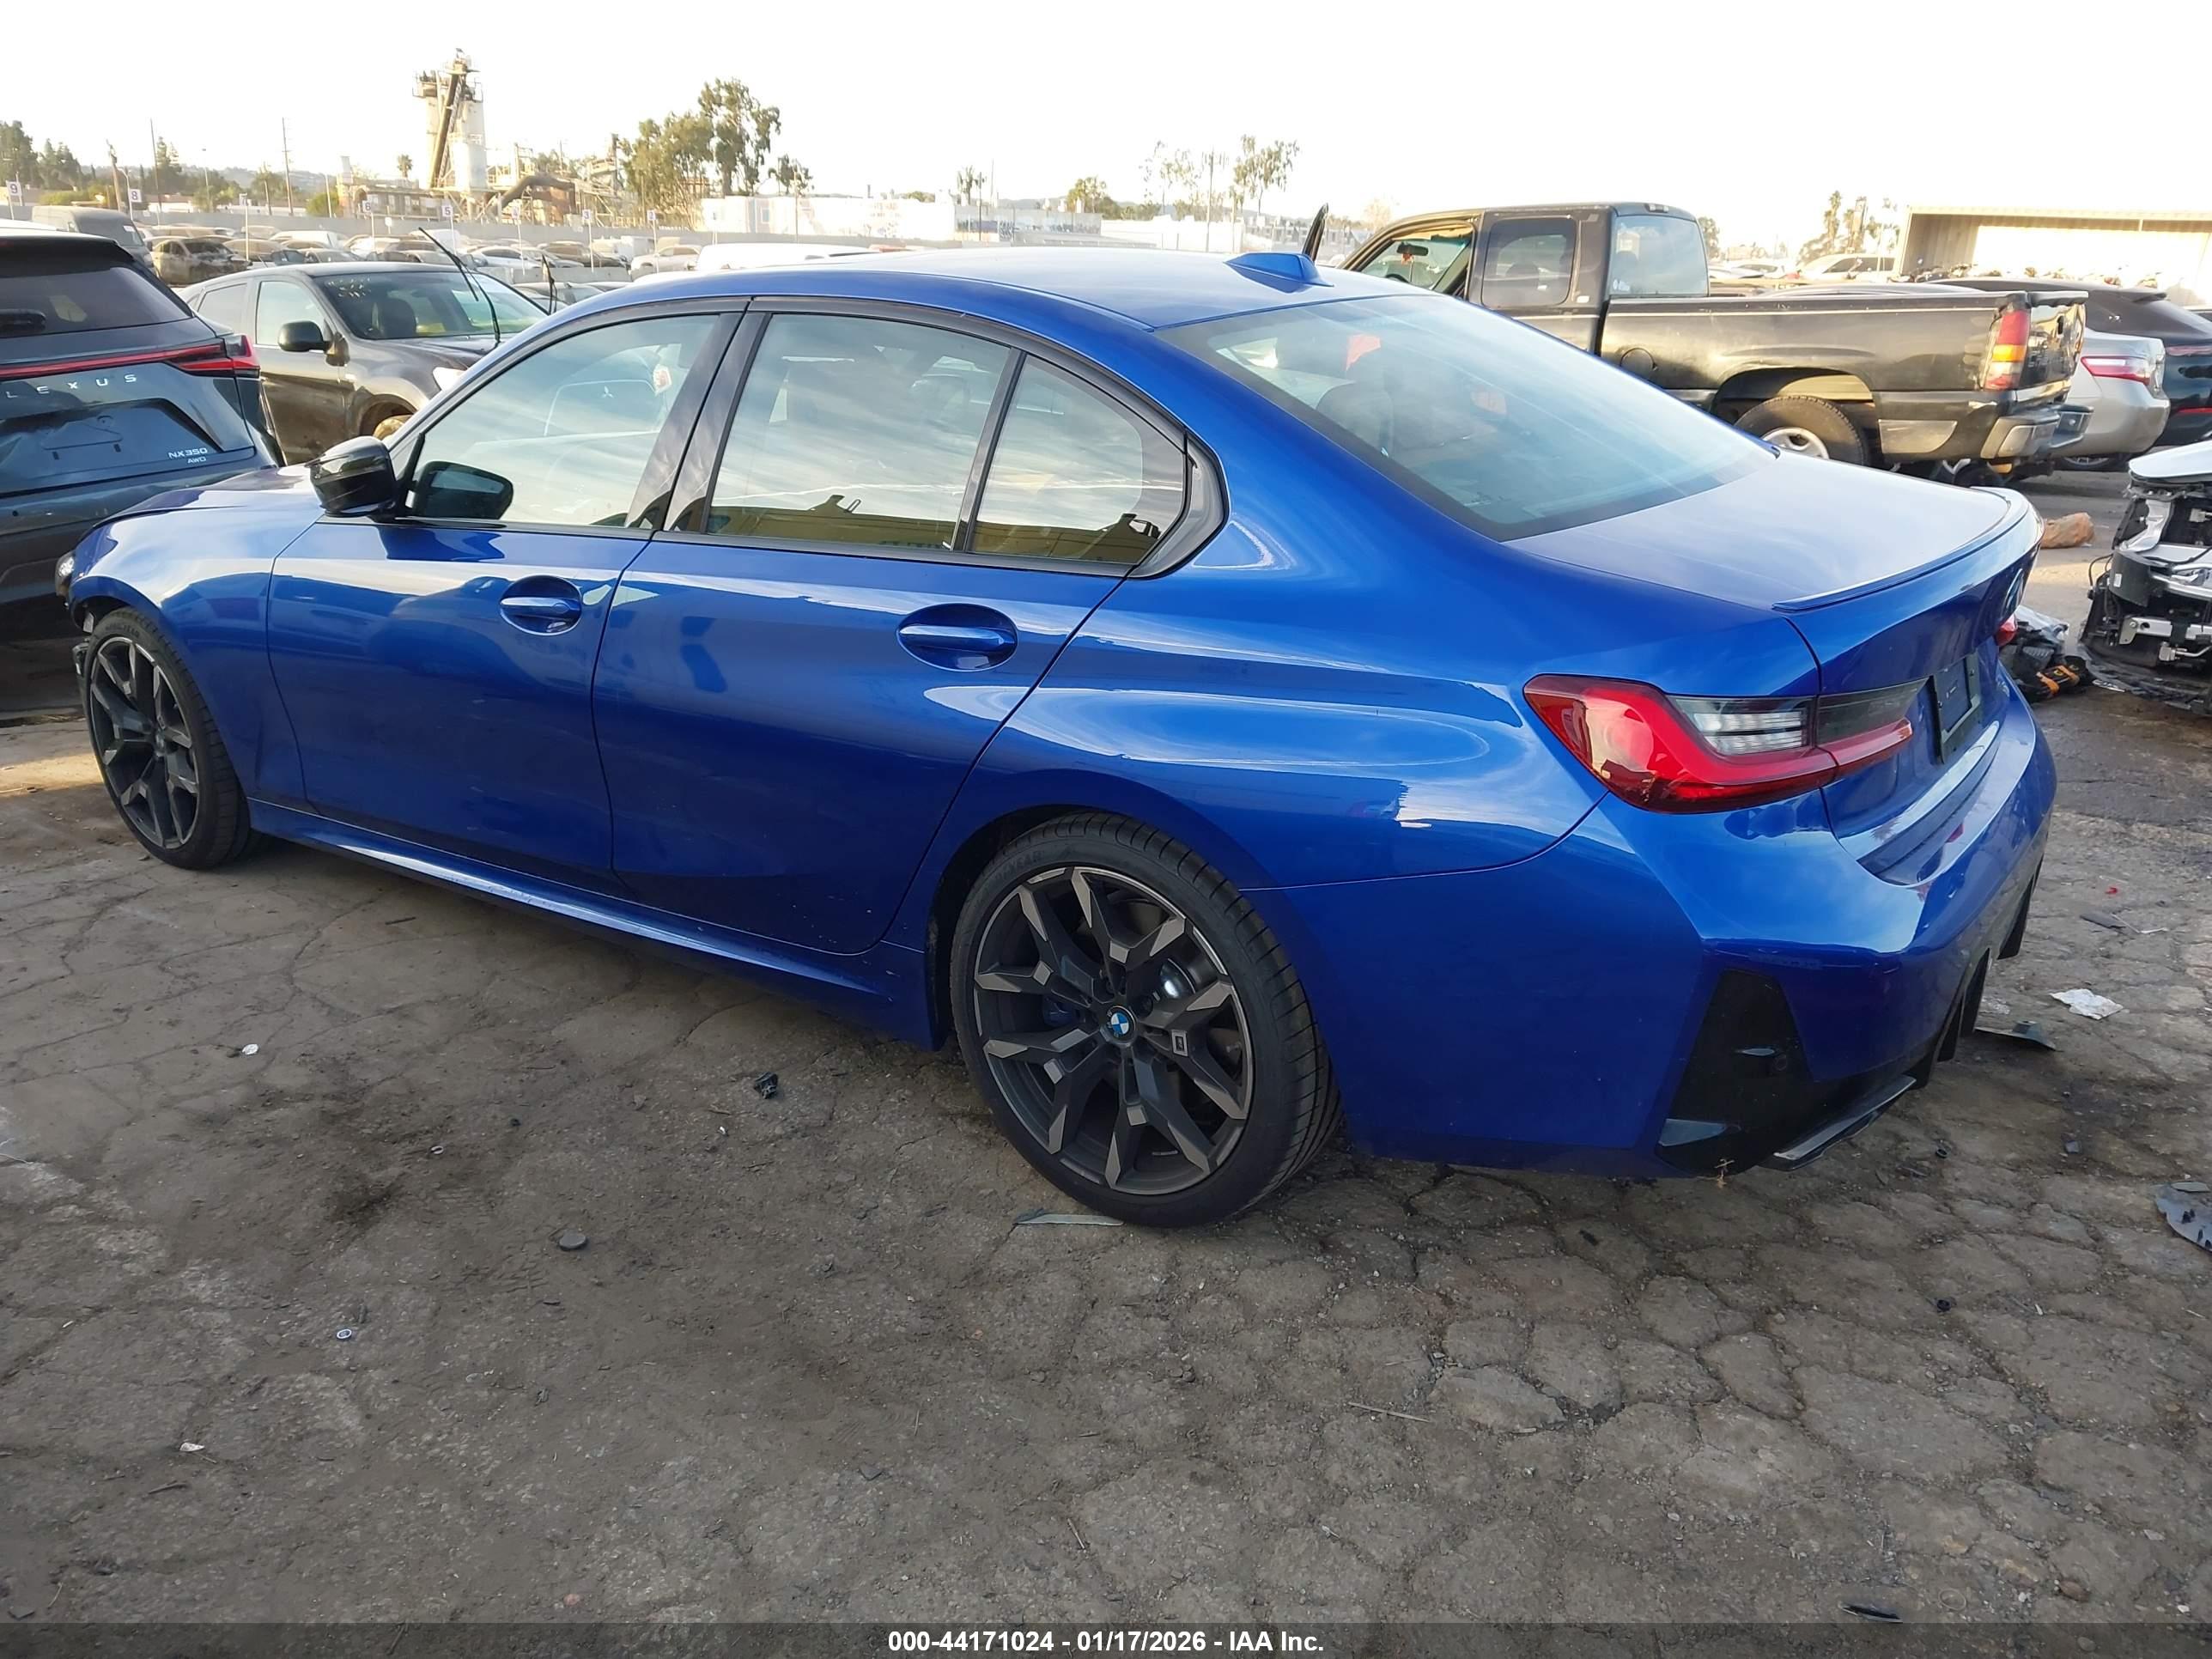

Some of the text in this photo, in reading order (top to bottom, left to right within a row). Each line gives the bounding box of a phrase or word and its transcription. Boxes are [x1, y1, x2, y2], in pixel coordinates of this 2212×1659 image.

[9, 184, 18, 194] 9
[131, 191, 138, 200] 8
[365, 201, 371, 211] 6
[444, 207, 451, 216] 5
[6, 374, 137, 398] LEXUS
